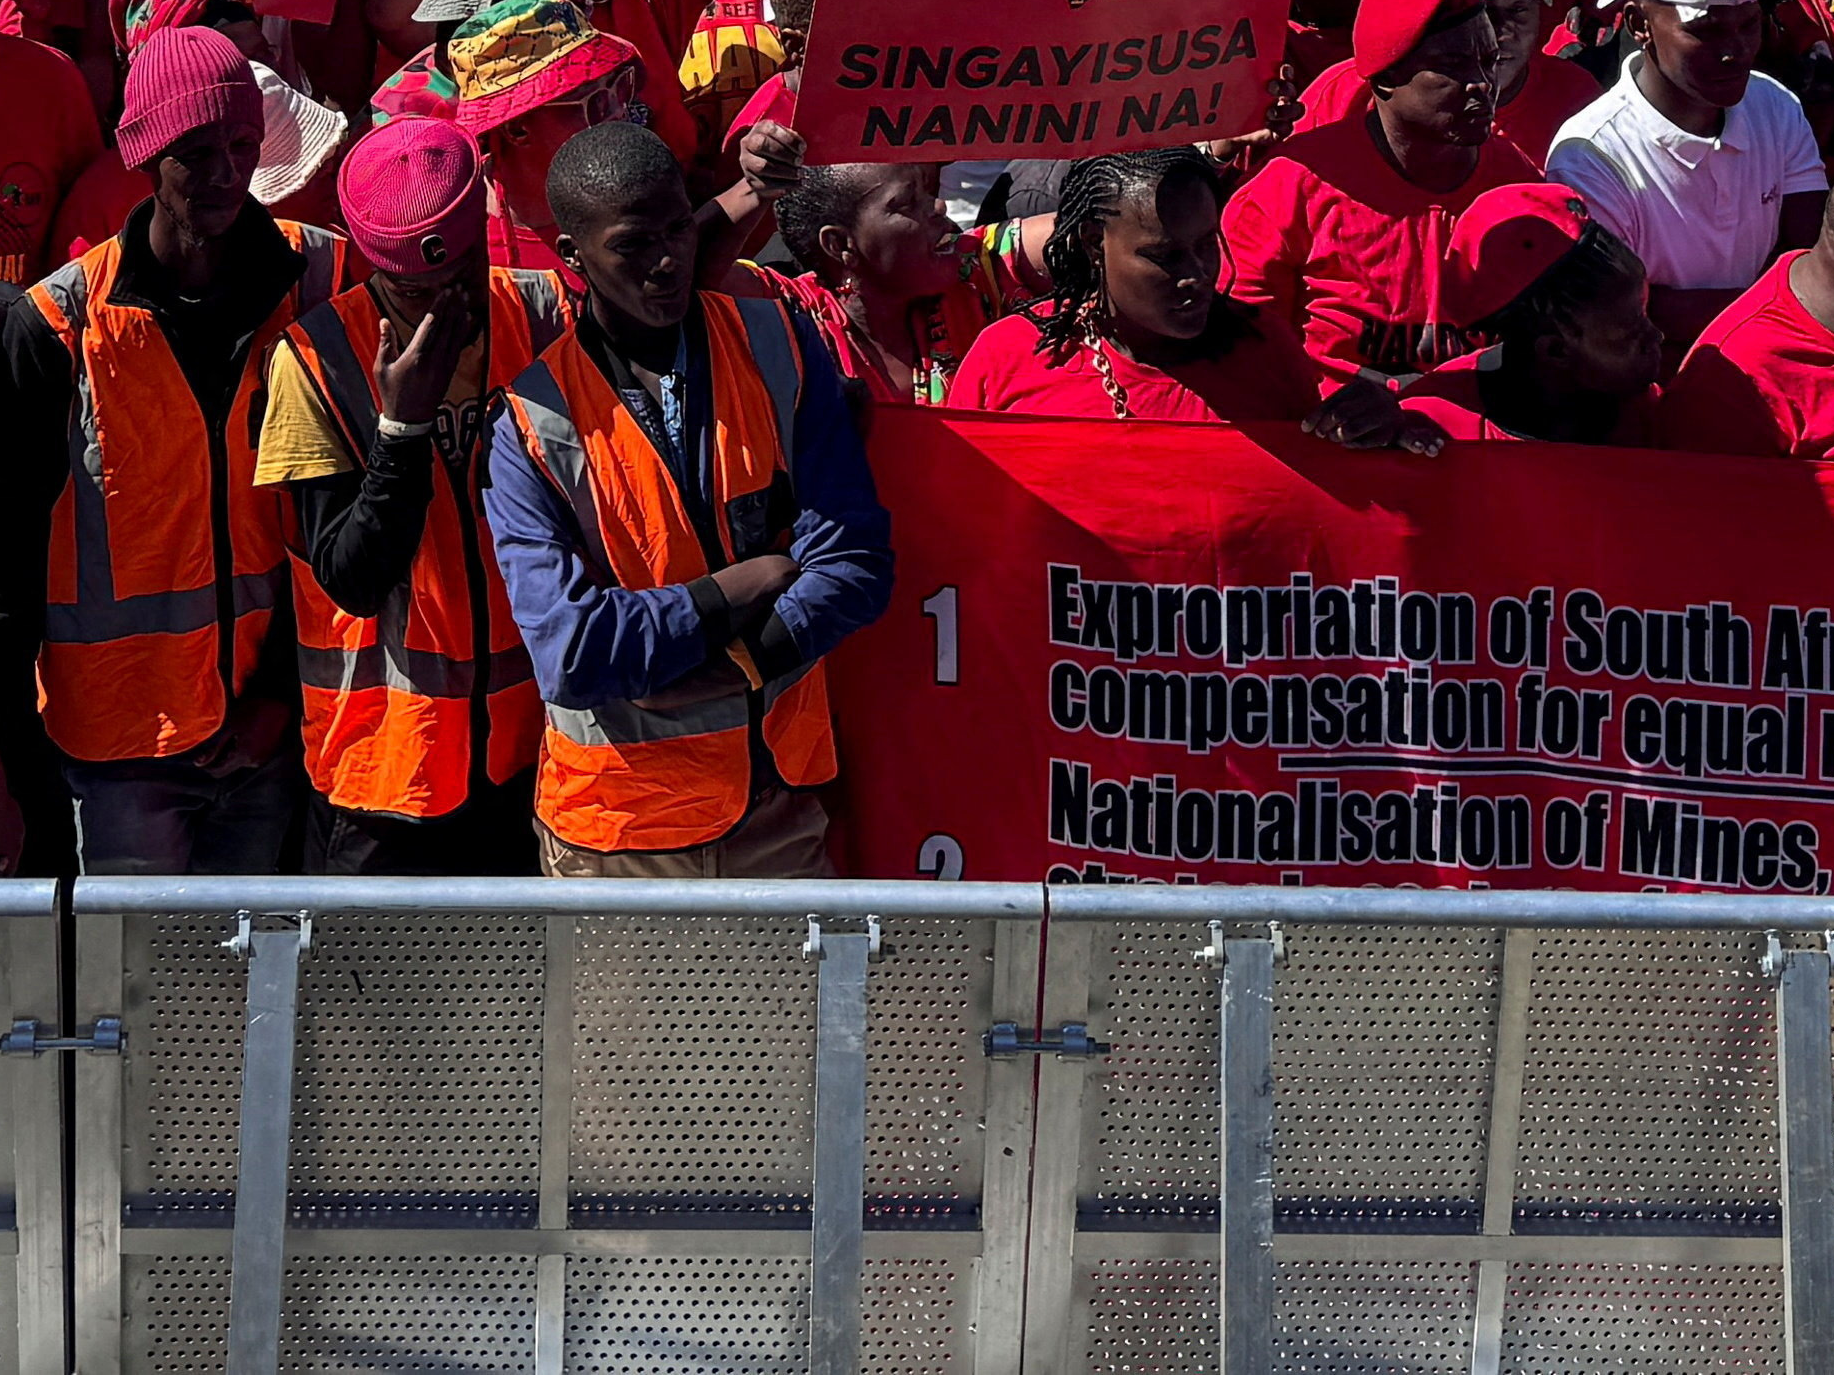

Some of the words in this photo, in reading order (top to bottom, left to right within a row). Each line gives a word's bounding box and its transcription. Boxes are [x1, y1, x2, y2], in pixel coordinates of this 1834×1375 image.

[722, 2, 758, 18] EFF
[834, 17, 1258, 90] SINGAYISUSA
[859, 101, 1102, 148] NANINI
[1115, 82, 1225, 139] NA!
[420, 234, 448, 266] C
[921, 585, 959, 686] 1
[1046, 562, 1476, 669] Expropriation
[1487, 586, 1553, 671] of
[1563, 587, 1752, 688] South
[1047, 661, 1504, 754] compensation
[1515, 671, 1613, 765] for
[1621, 693, 1806, 784] equal
[1047, 756, 1532, 870] Nationalisation
[1542, 791, 1611, 873] of
[1621, 794, 1834, 897] Mines,
